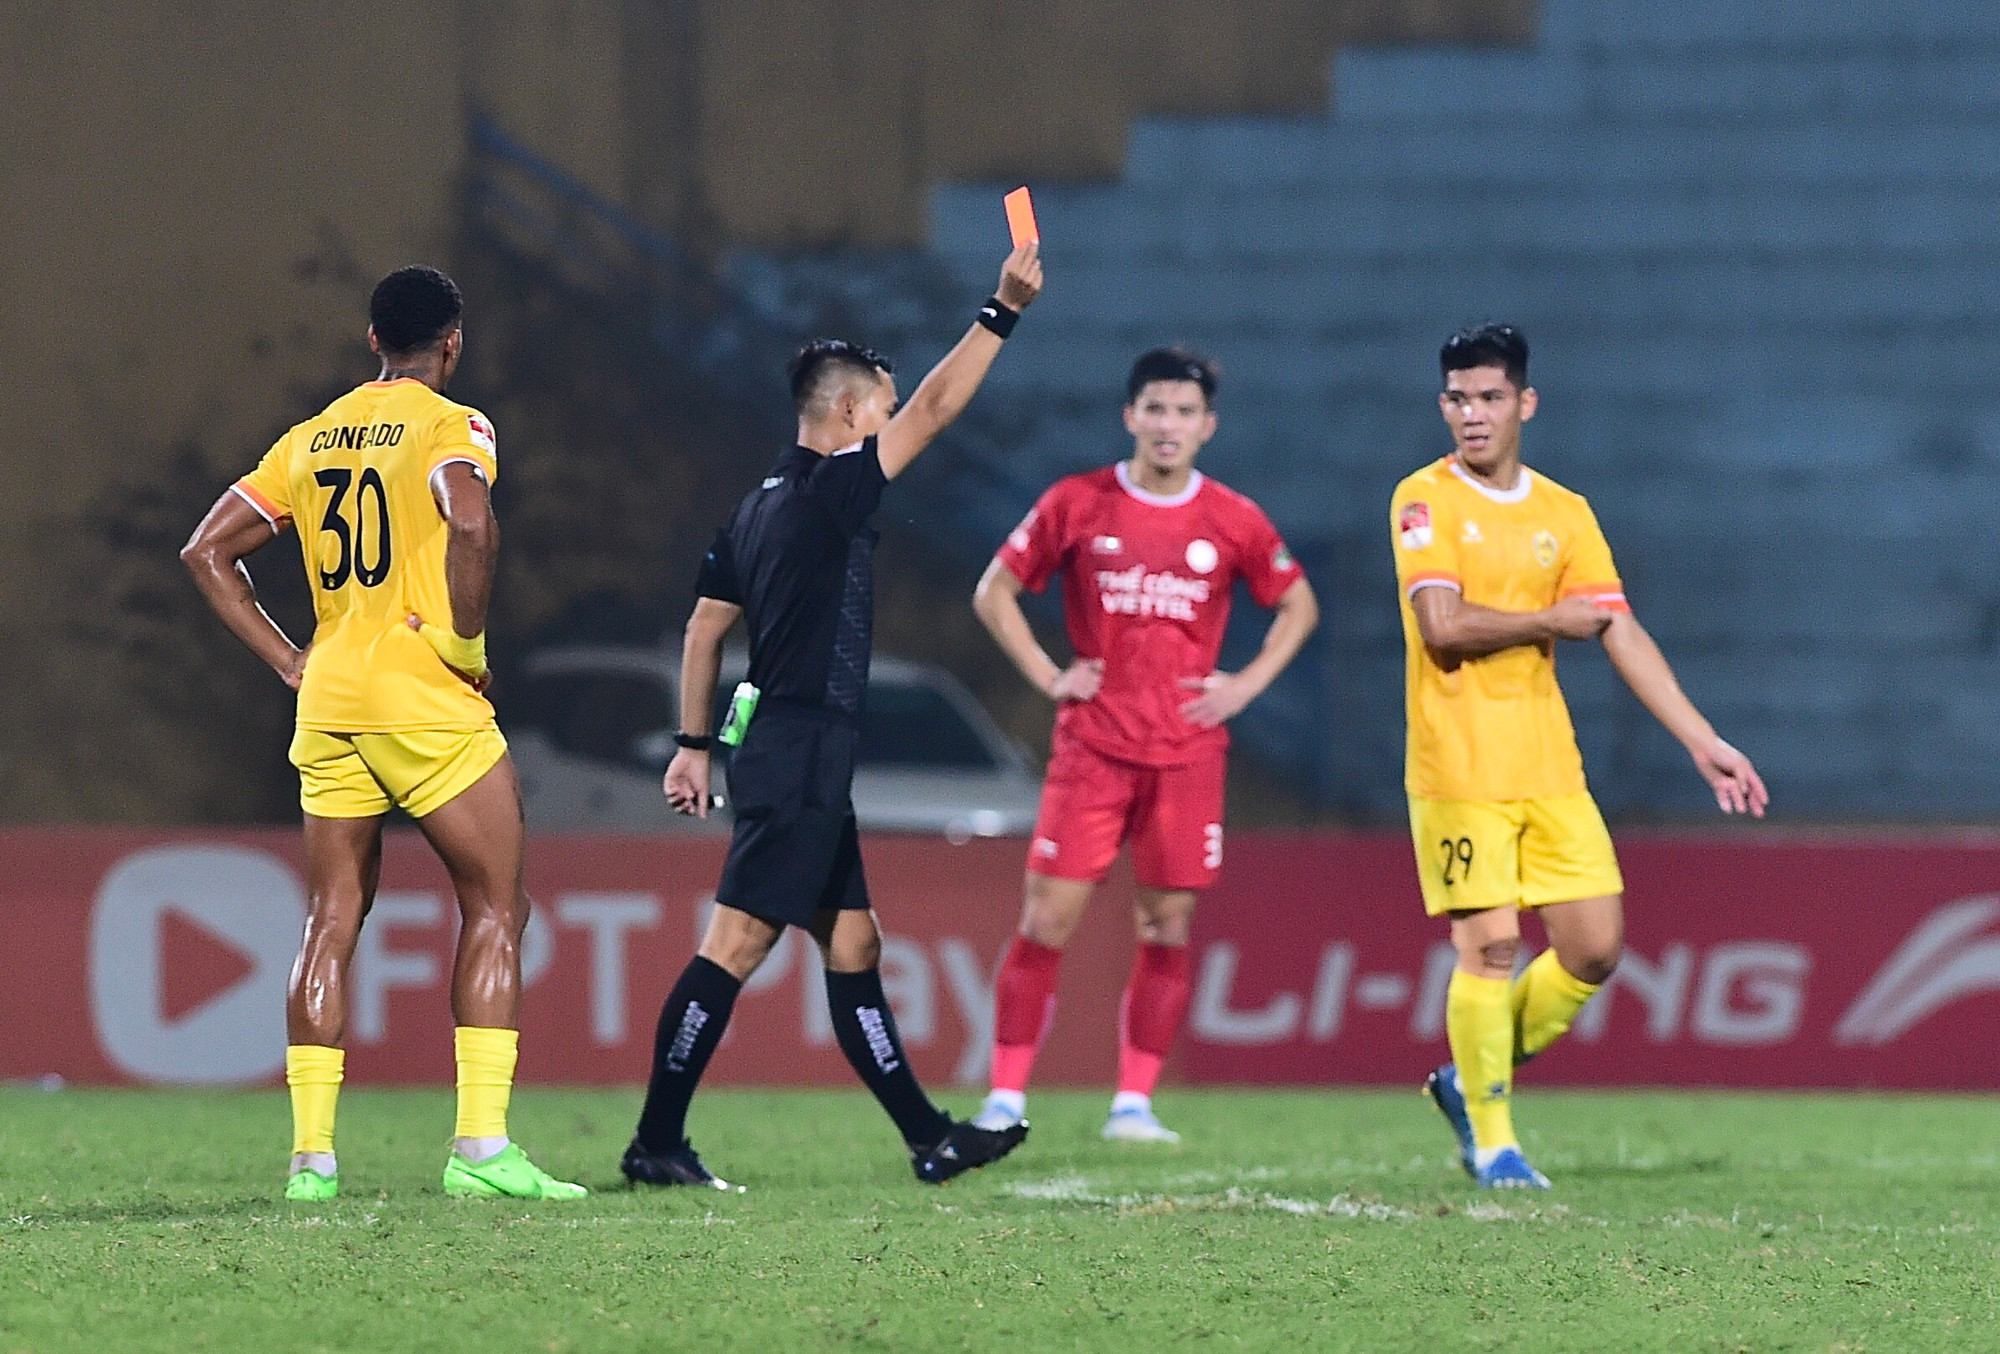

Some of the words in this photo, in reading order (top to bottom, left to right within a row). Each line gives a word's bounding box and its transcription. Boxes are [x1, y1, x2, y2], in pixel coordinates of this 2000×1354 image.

[314, 467, 391, 590] 30
[1101, 590, 1198, 622] VIETTEL
[1203, 823, 1224, 870] 3
[1440, 837, 1474, 886] 29
